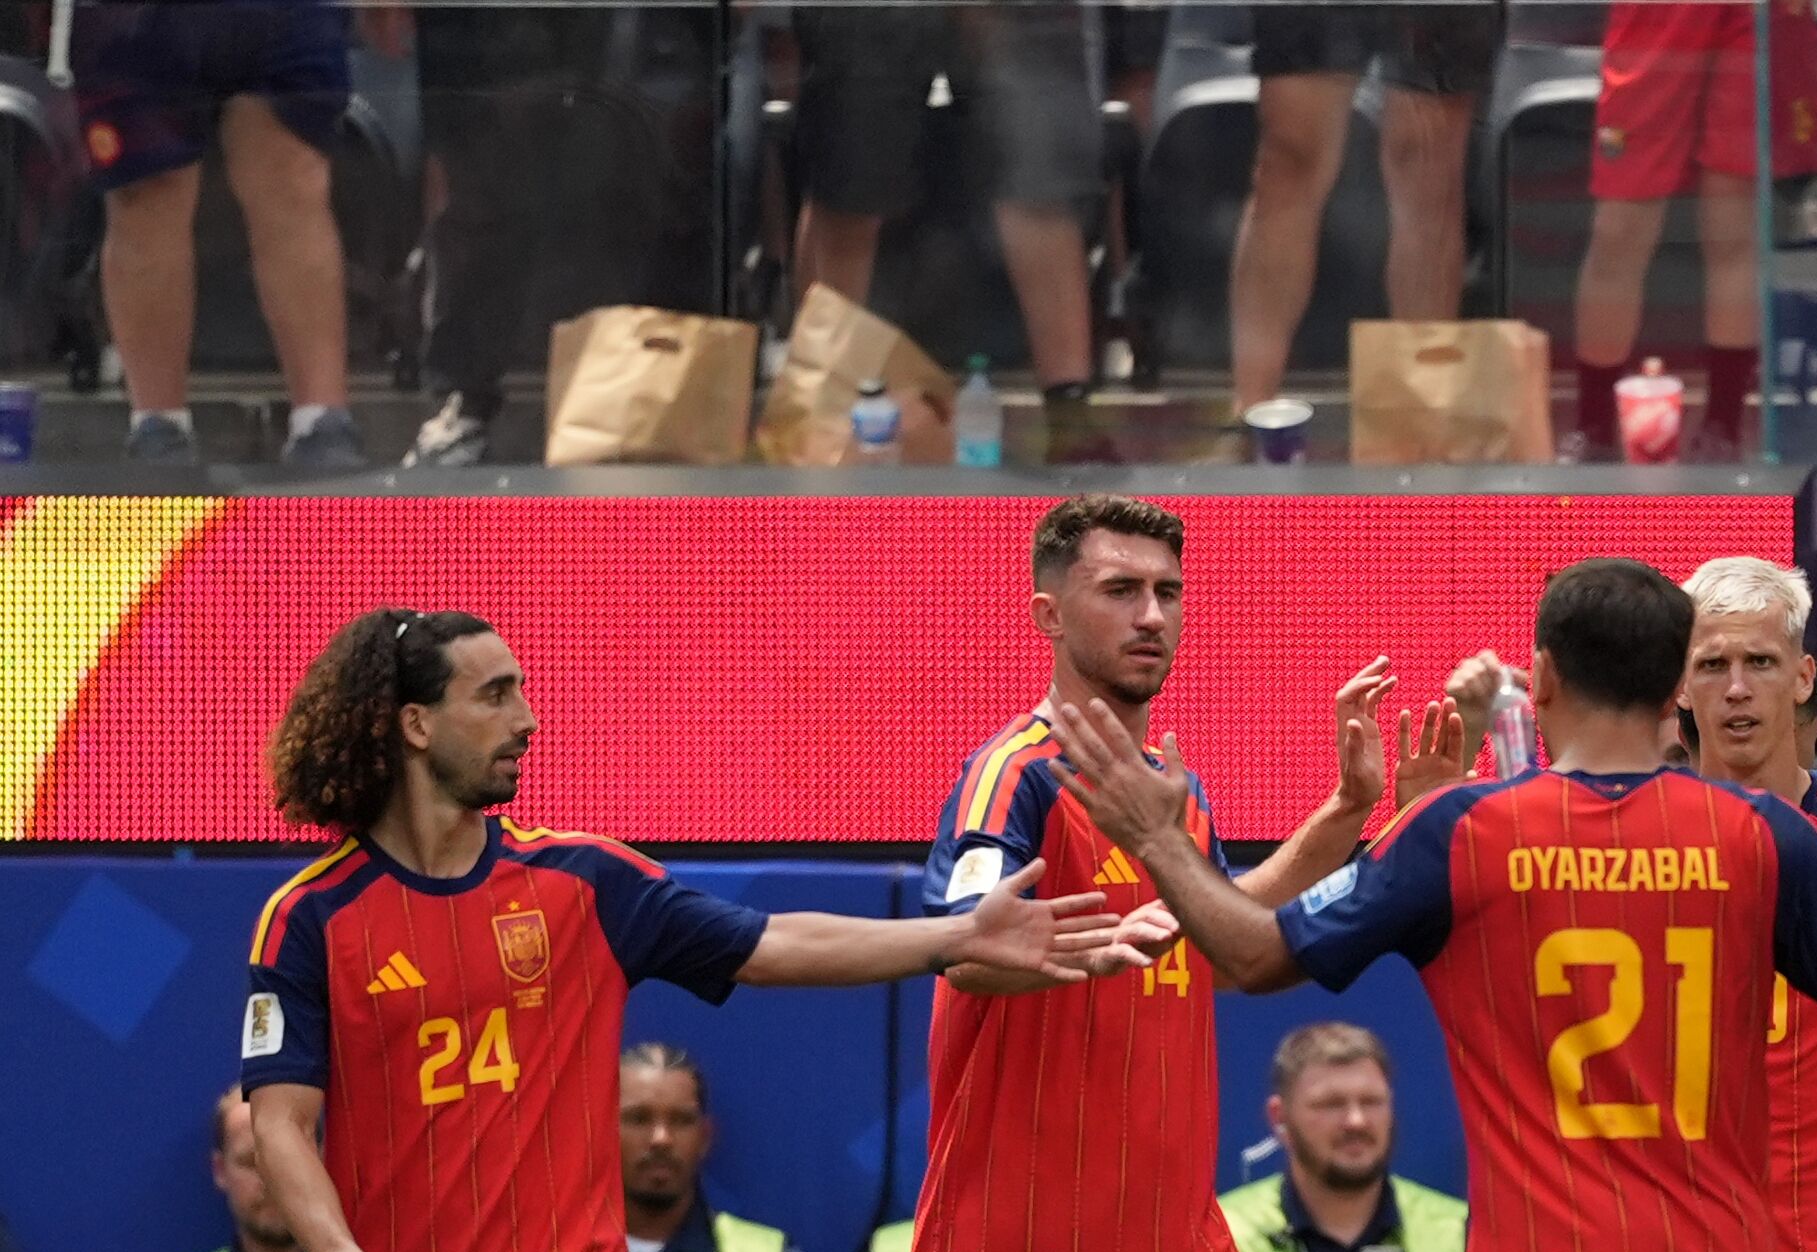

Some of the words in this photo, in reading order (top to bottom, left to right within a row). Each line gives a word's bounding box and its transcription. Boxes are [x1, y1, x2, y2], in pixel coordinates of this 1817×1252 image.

[1507, 846, 1730, 892] OYARZABAL
[418, 1007, 520, 1105] 24
[1535, 927, 1713, 1141] 21
